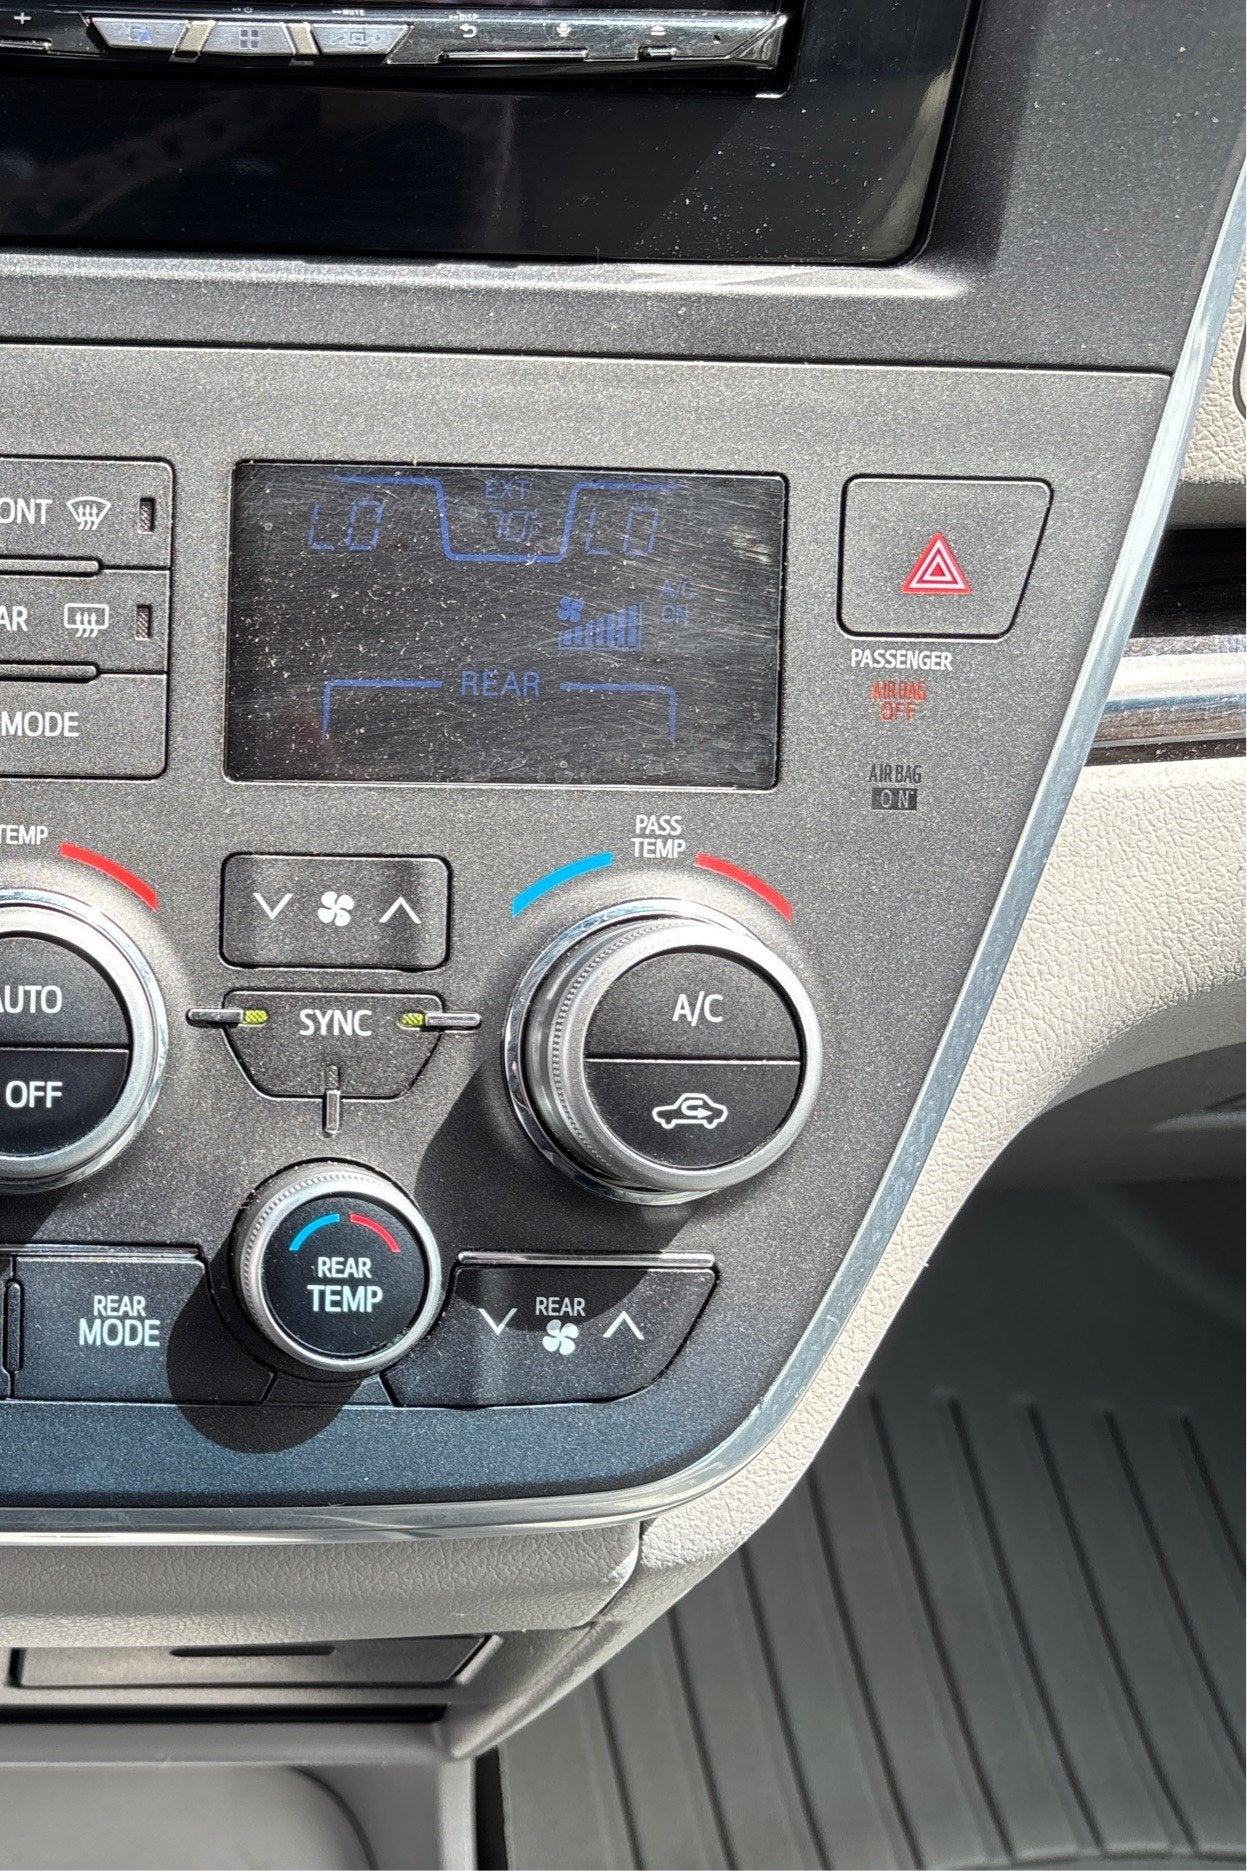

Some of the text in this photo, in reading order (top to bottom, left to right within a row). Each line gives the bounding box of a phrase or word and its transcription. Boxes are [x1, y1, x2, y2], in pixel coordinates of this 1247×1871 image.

[485, 479, 529, 500] EXT
[851, 649, 952, 671] PASSENGER
[460, 671, 540, 697] REAR
[880, 702, 917, 721] OFF
[0, 711, 80, 737] MODE
[880, 789, 910, 809] ON
[635, 815, 682, 835] PASS
[631, 838, 687, 858] TEMP
[672, 990, 723, 1027] A/C
[299, 1008, 372, 1037] SYNC
[5, 1081, 63, 1109] OFF
[317, 1257, 372, 1279] REAR
[93, 1295, 146, 1317] REAR
[307, 1284, 384, 1313] TEMP
[535, 1297, 586, 1317] REAR
[79, 1318, 161, 1347] MODE
